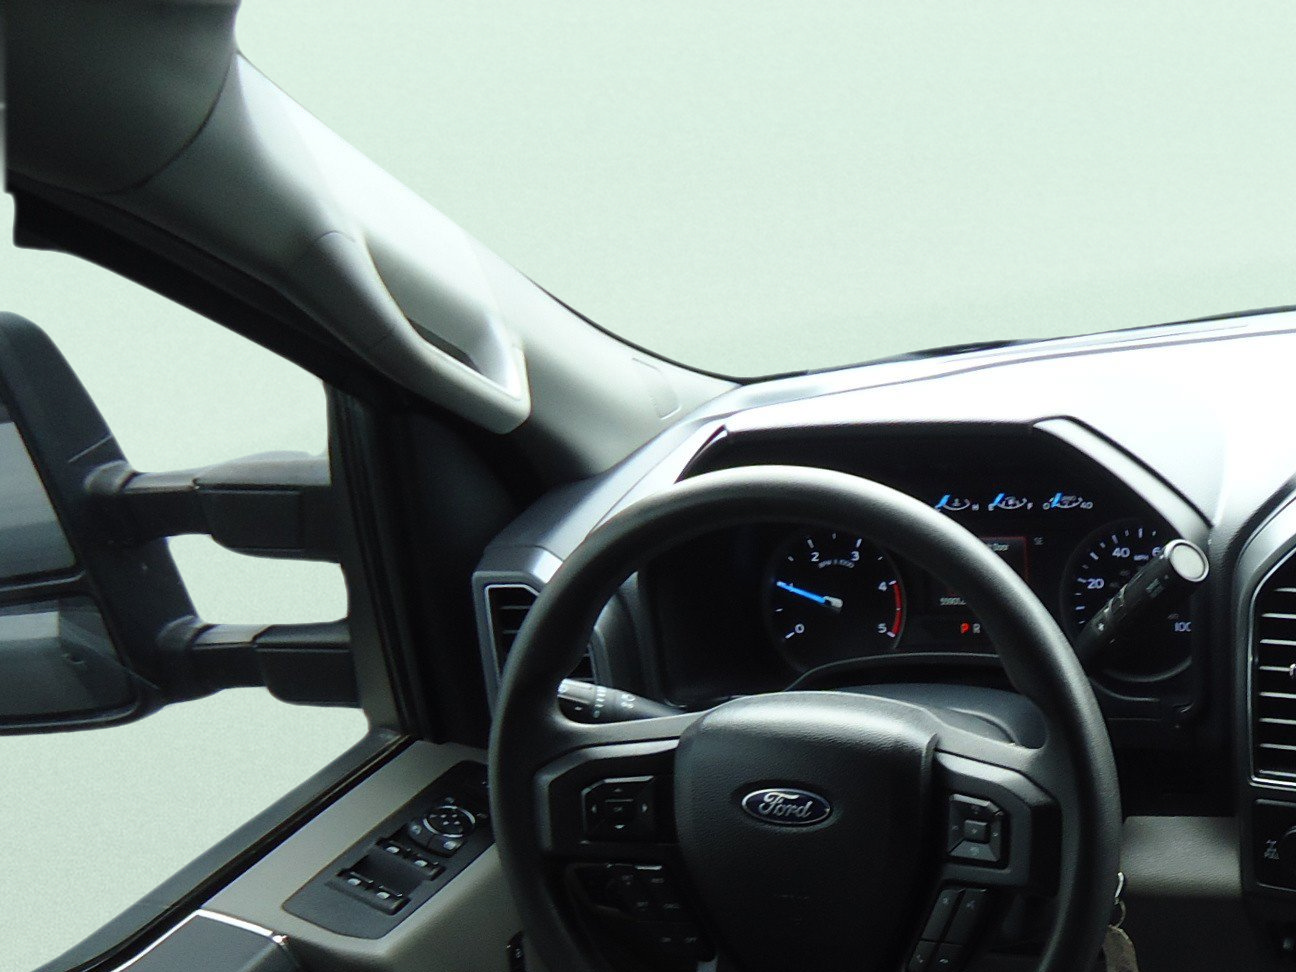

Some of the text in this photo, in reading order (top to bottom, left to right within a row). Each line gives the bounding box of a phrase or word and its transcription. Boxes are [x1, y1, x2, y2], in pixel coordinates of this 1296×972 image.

[810, 551, 820, 562] 2
[850, 550, 860, 561] 3
[1111, 547, 1131, 558] 40
[877, 581, 888, 592] 4
[1086, 578, 1105, 589] 20
[794, 622, 805, 634] 0
[877, 622, 888, 634] 5
[960, 622, 971, 634] P
[758, 792, 814, 818] Ford
